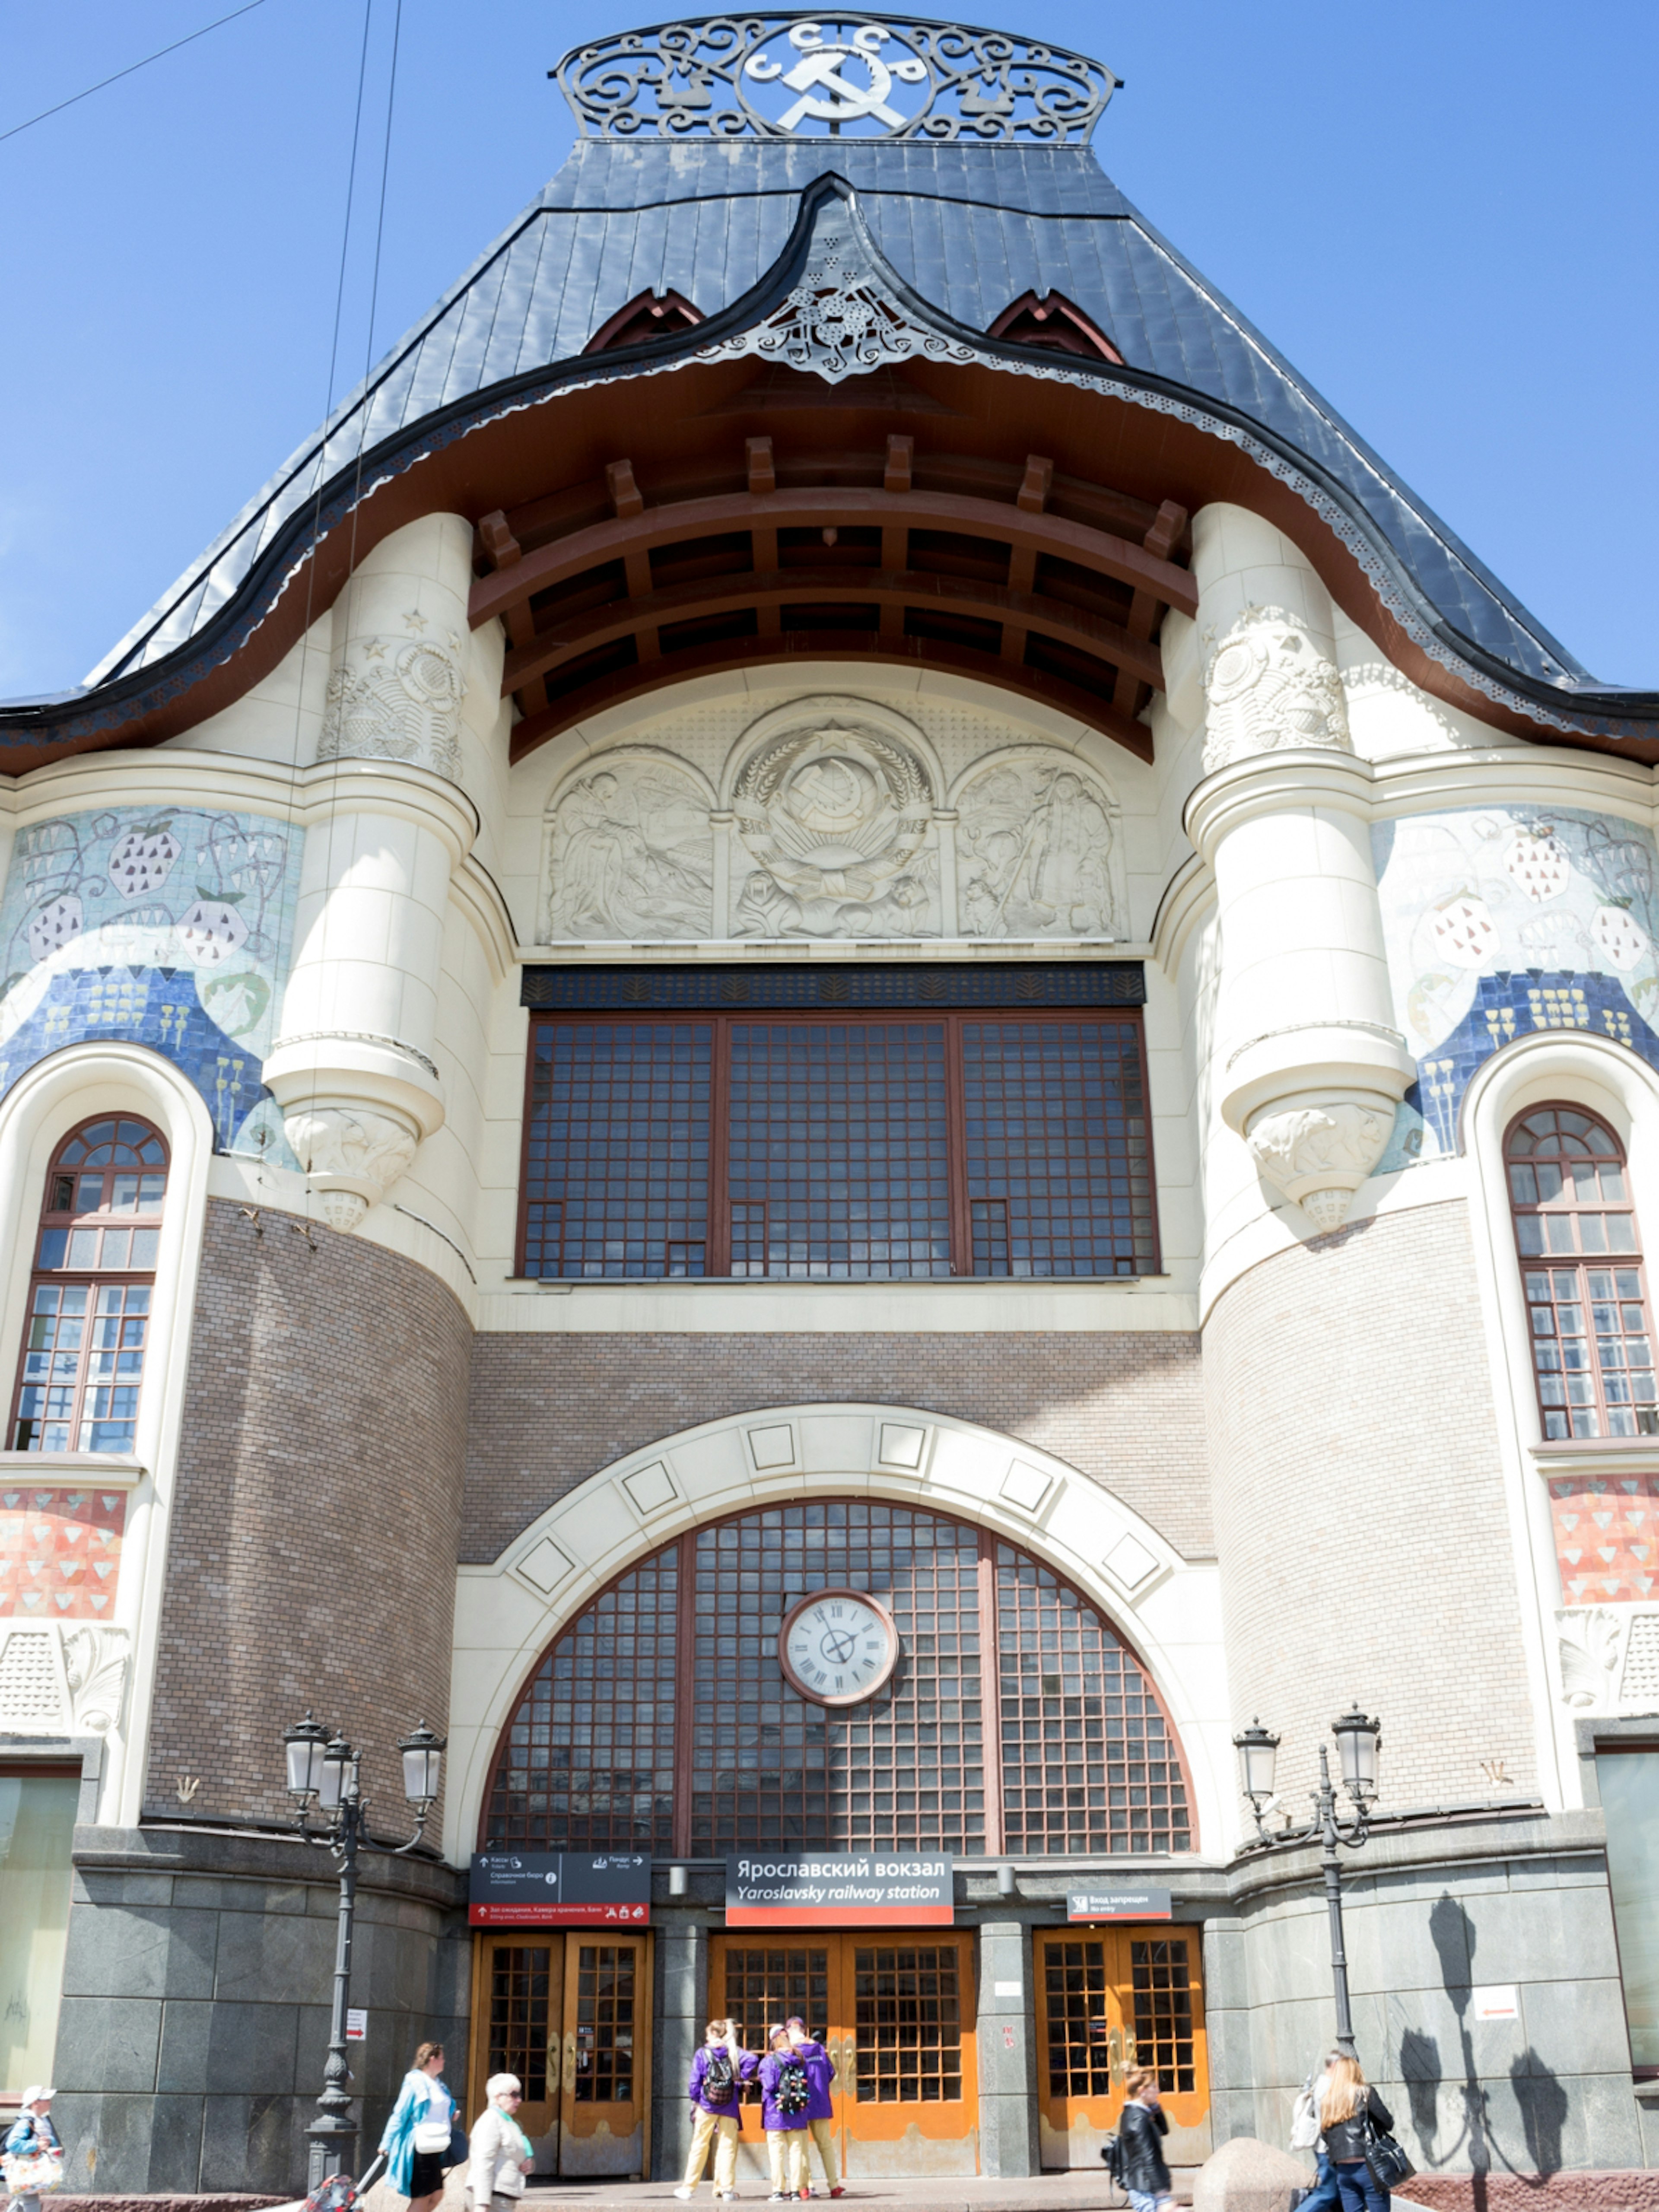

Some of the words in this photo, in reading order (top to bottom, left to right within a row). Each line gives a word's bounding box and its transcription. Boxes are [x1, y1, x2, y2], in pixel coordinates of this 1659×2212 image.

[744, 23, 928, 84] СССР
[526, 1871, 544, 1879] бюро
[737, 1858, 869, 1882] Ярославский
[875, 1862, 945, 1877] вокзал
[737, 1885, 826, 1903] Yaroslavsky
[828, 1884, 885, 1903] railway
[887, 1885, 940, 1899] station
[1090, 1896, 1109, 1904] Вход
